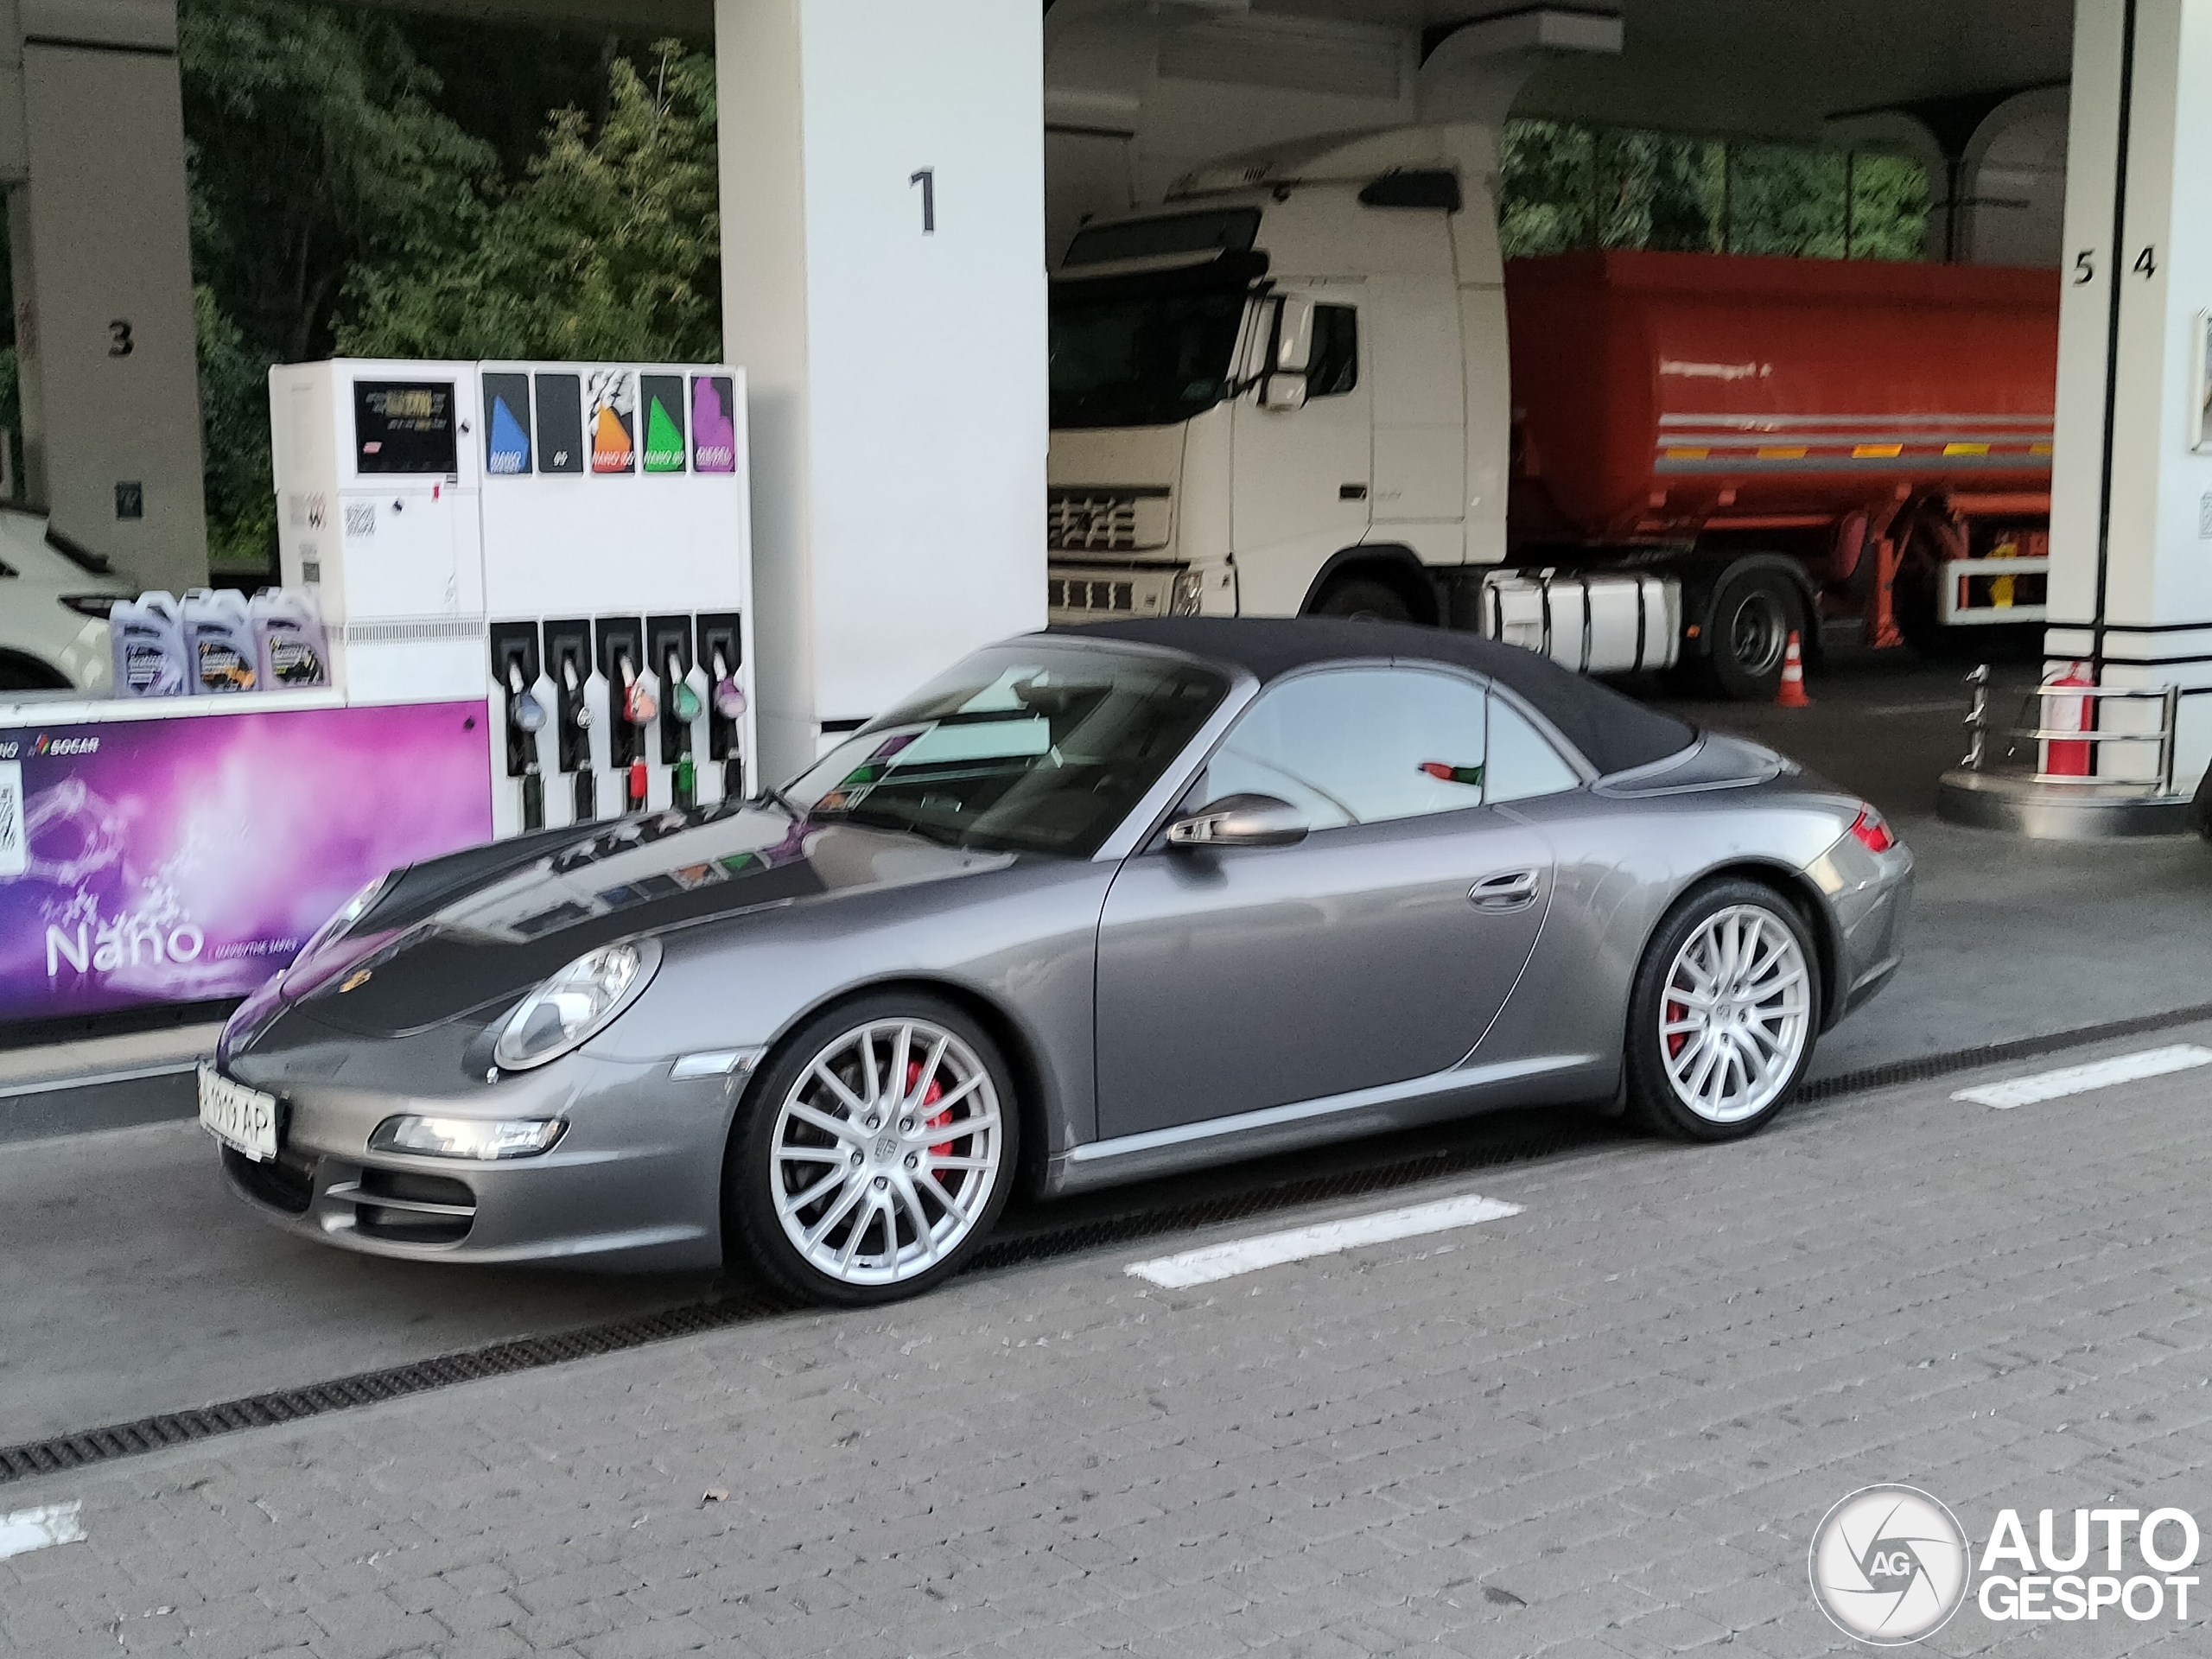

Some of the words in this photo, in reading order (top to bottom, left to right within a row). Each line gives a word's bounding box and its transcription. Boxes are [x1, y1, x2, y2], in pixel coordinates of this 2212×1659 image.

[908, 165, 936, 237] 1
[2073, 247, 2095, 287] 5
[2132, 245, 2158, 281] 4
[108, 318, 135, 359] 3
[46, 923, 205, 976] Nano
